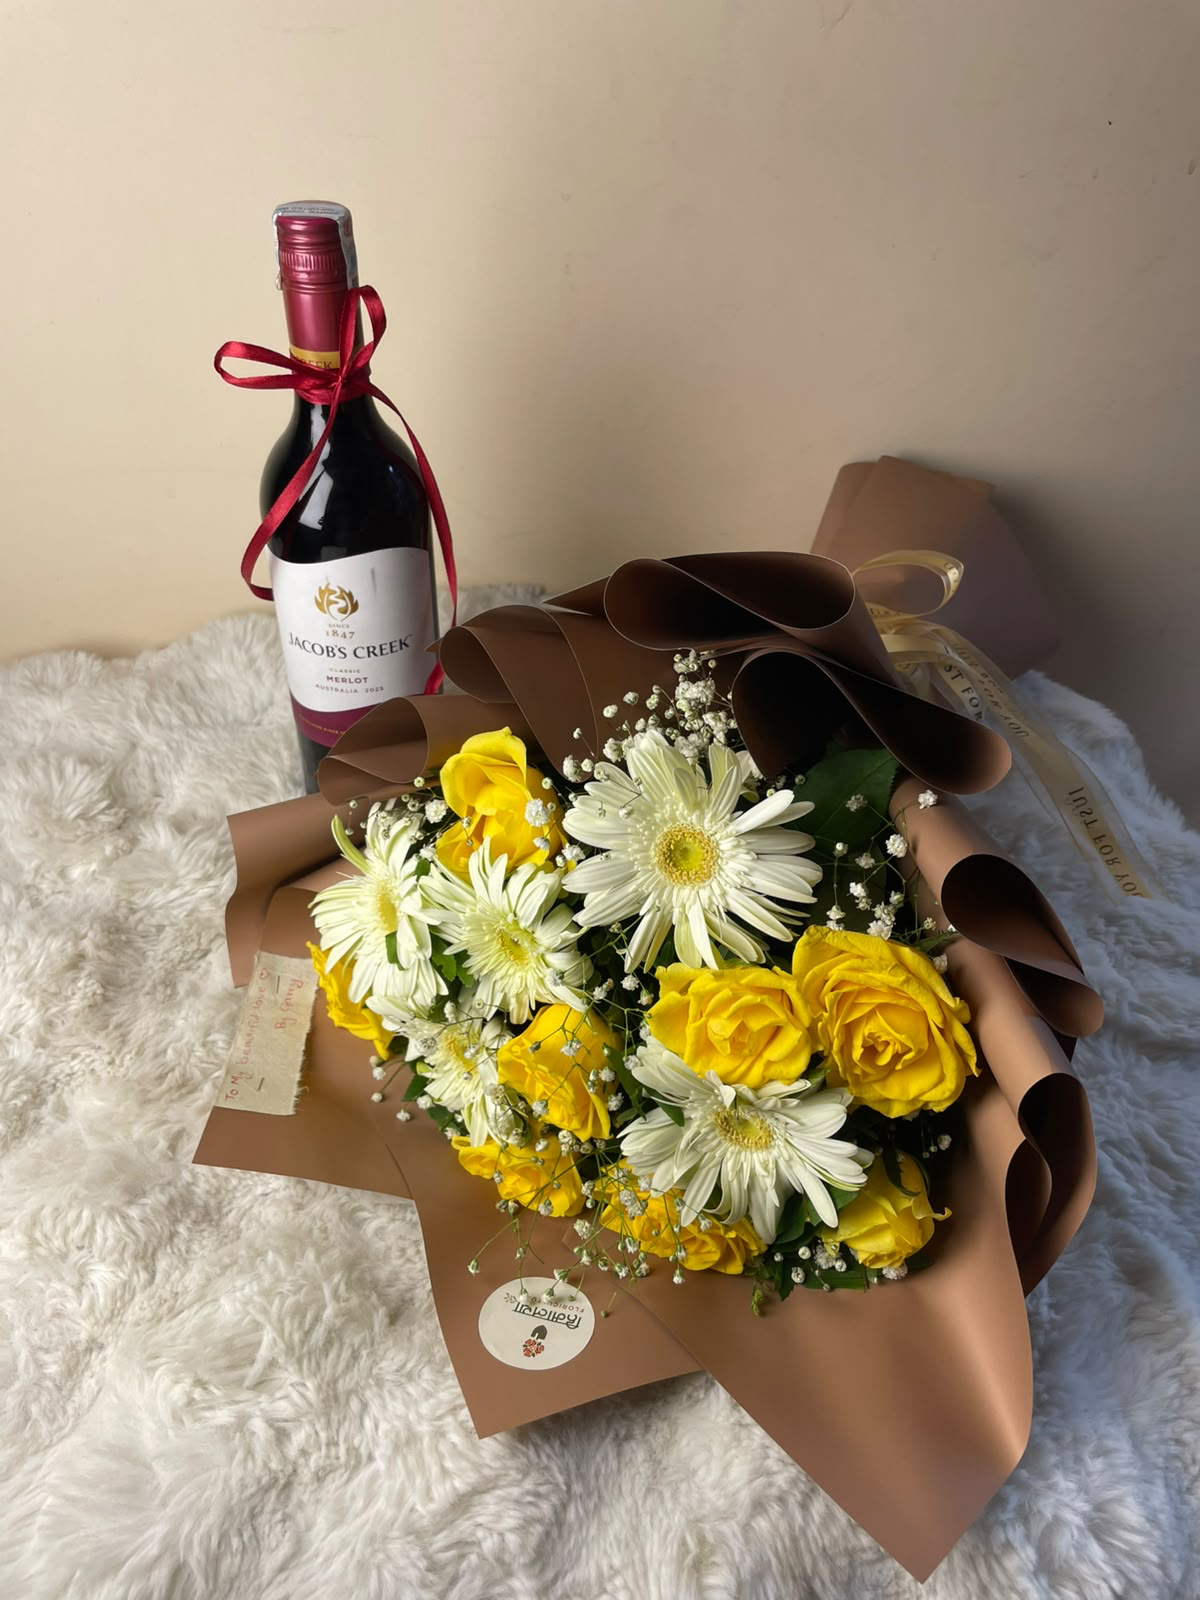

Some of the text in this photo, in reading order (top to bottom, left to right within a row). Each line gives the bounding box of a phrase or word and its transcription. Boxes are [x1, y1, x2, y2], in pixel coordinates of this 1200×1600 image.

[325, 629, 355, 640] 1847
[288, 632, 411, 660] JACOB'S CREEK
[326, 675, 369, 684] MERLOT
[315, 683, 359, 693] AUSTRALIA
[527, 1296, 584, 1312] FLORICUTU
